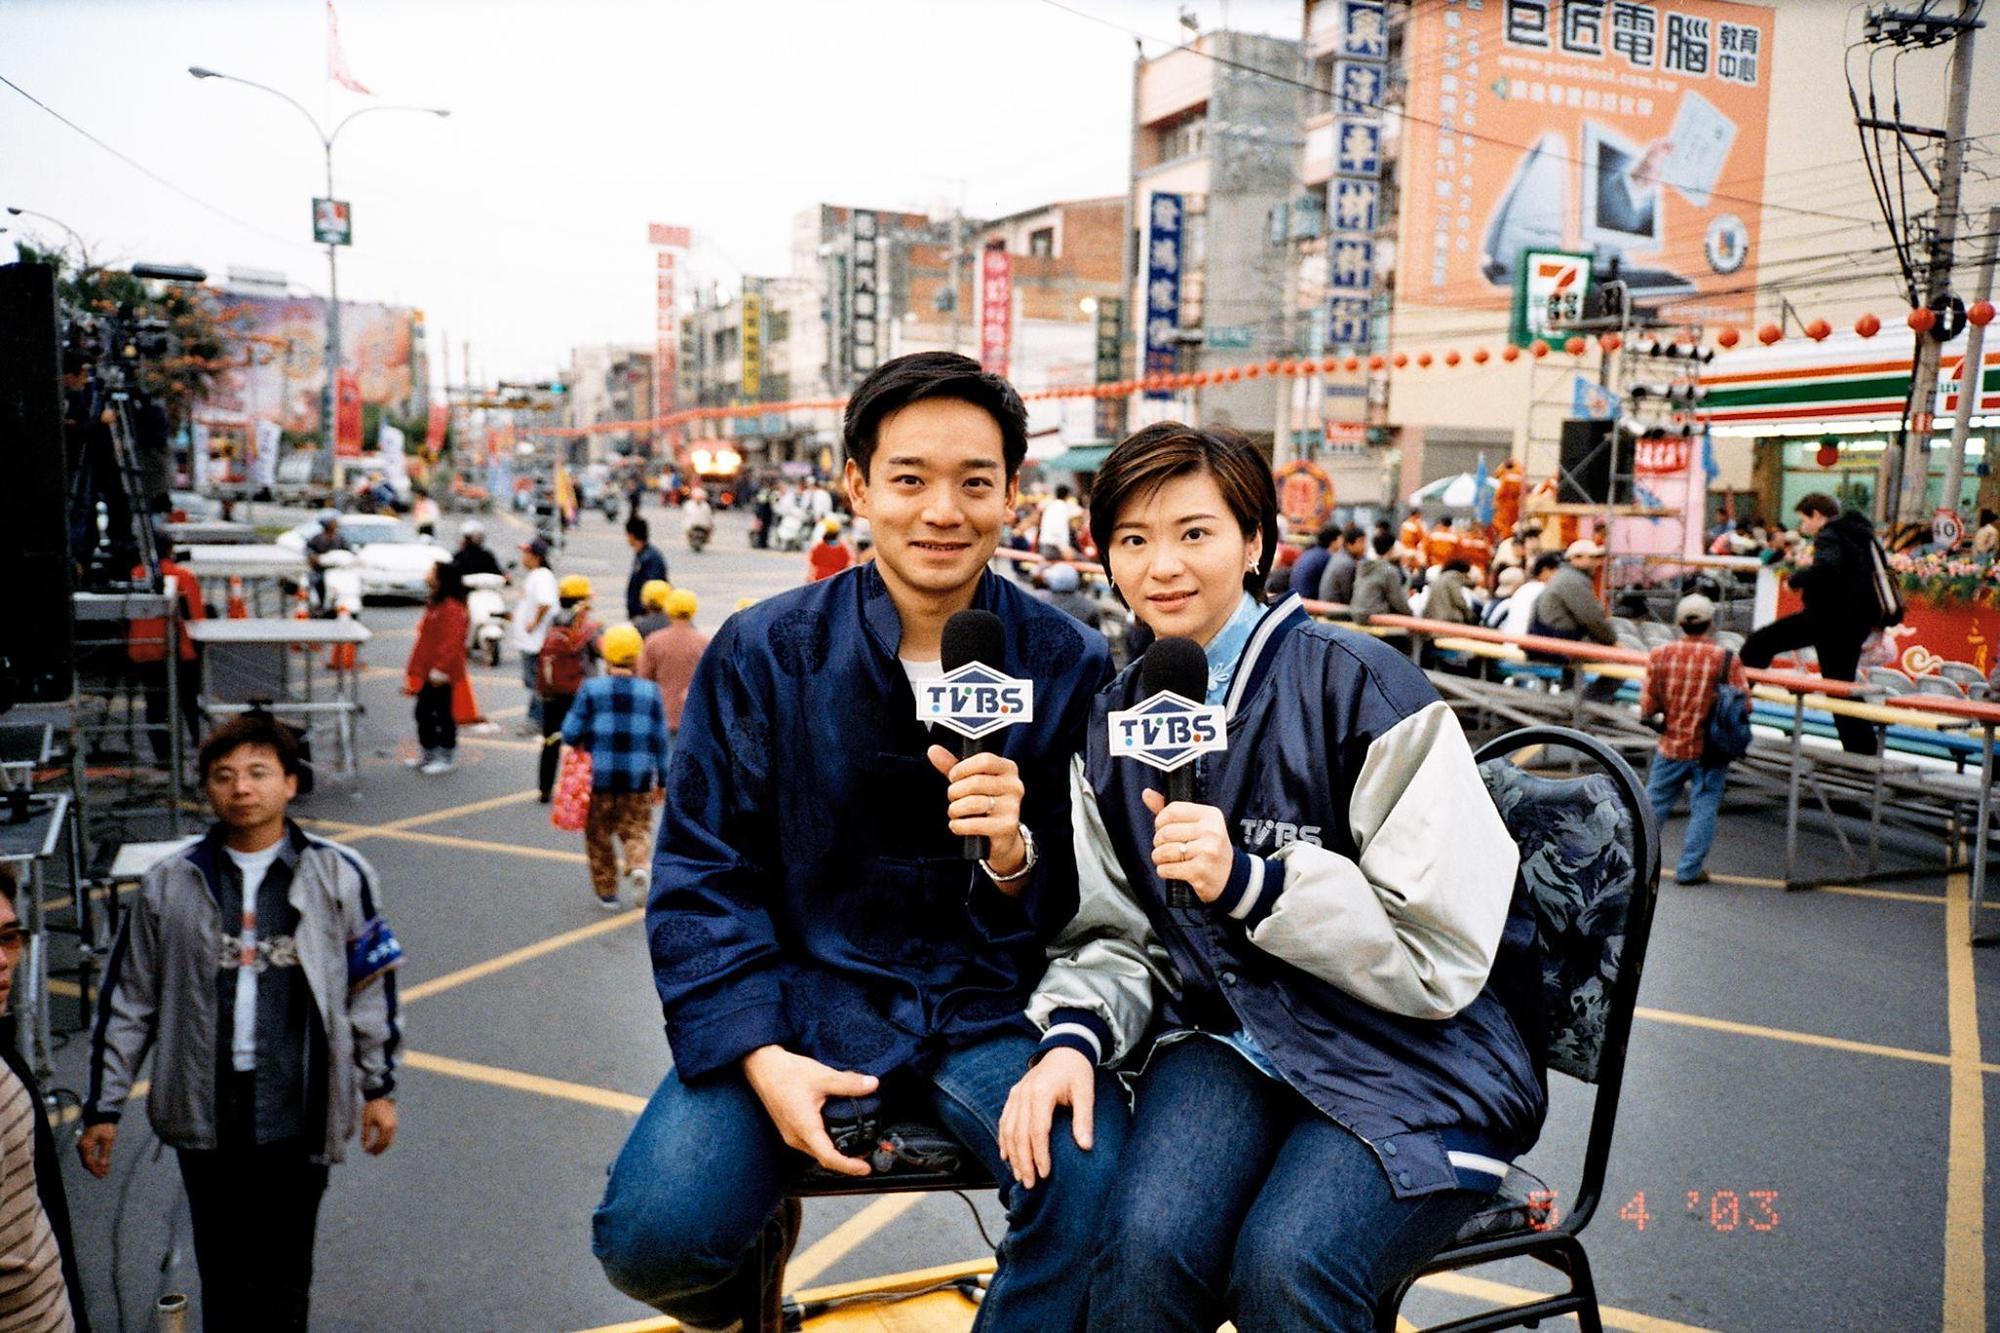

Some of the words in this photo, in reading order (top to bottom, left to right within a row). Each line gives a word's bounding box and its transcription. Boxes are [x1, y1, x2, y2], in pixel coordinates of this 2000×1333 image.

[1506, 0, 1710, 74] 巨匠電腦
[926, 686, 1025, 714] TVBS
[1119, 713, 1217, 745] TVBS
[1240, 818, 1323, 848] TVBS
